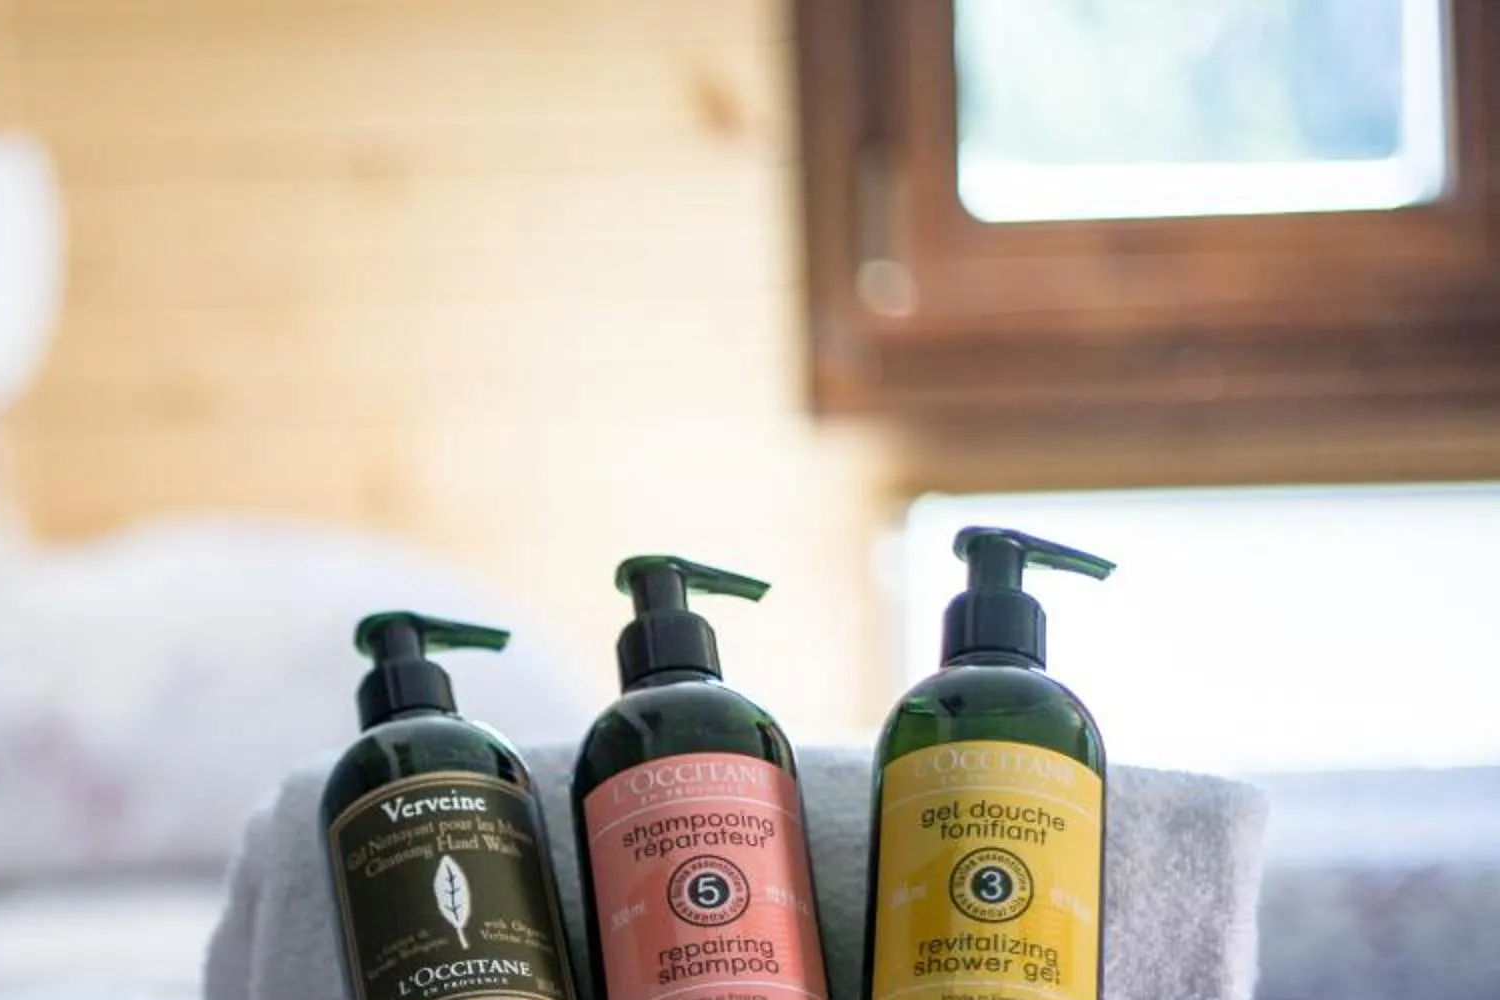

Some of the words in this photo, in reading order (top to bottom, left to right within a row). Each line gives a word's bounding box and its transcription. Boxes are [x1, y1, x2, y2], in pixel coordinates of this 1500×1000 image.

[381, 789, 488, 823] Verveine
[921, 801, 960, 829] gel
[969, 800, 1067, 832] douche
[436, 834, 479, 852] Hand
[622, 810, 776, 849] shampooing
[633, 828, 768, 861] réparateur
[940, 818, 1049, 845] tonifiant
[697, 875, 720, 905] 5
[979, 870, 1004, 900] 3
[658, 935, 775, 967] repairing
[918, 933, 1058, 967] revitalizing
[398, 959, 534, 997] L'OCCITANE
[658, 955, 780, 986] shampoo
[913, 953, 1013, 978] shower
[1023, 959, 1062, 985] gel
